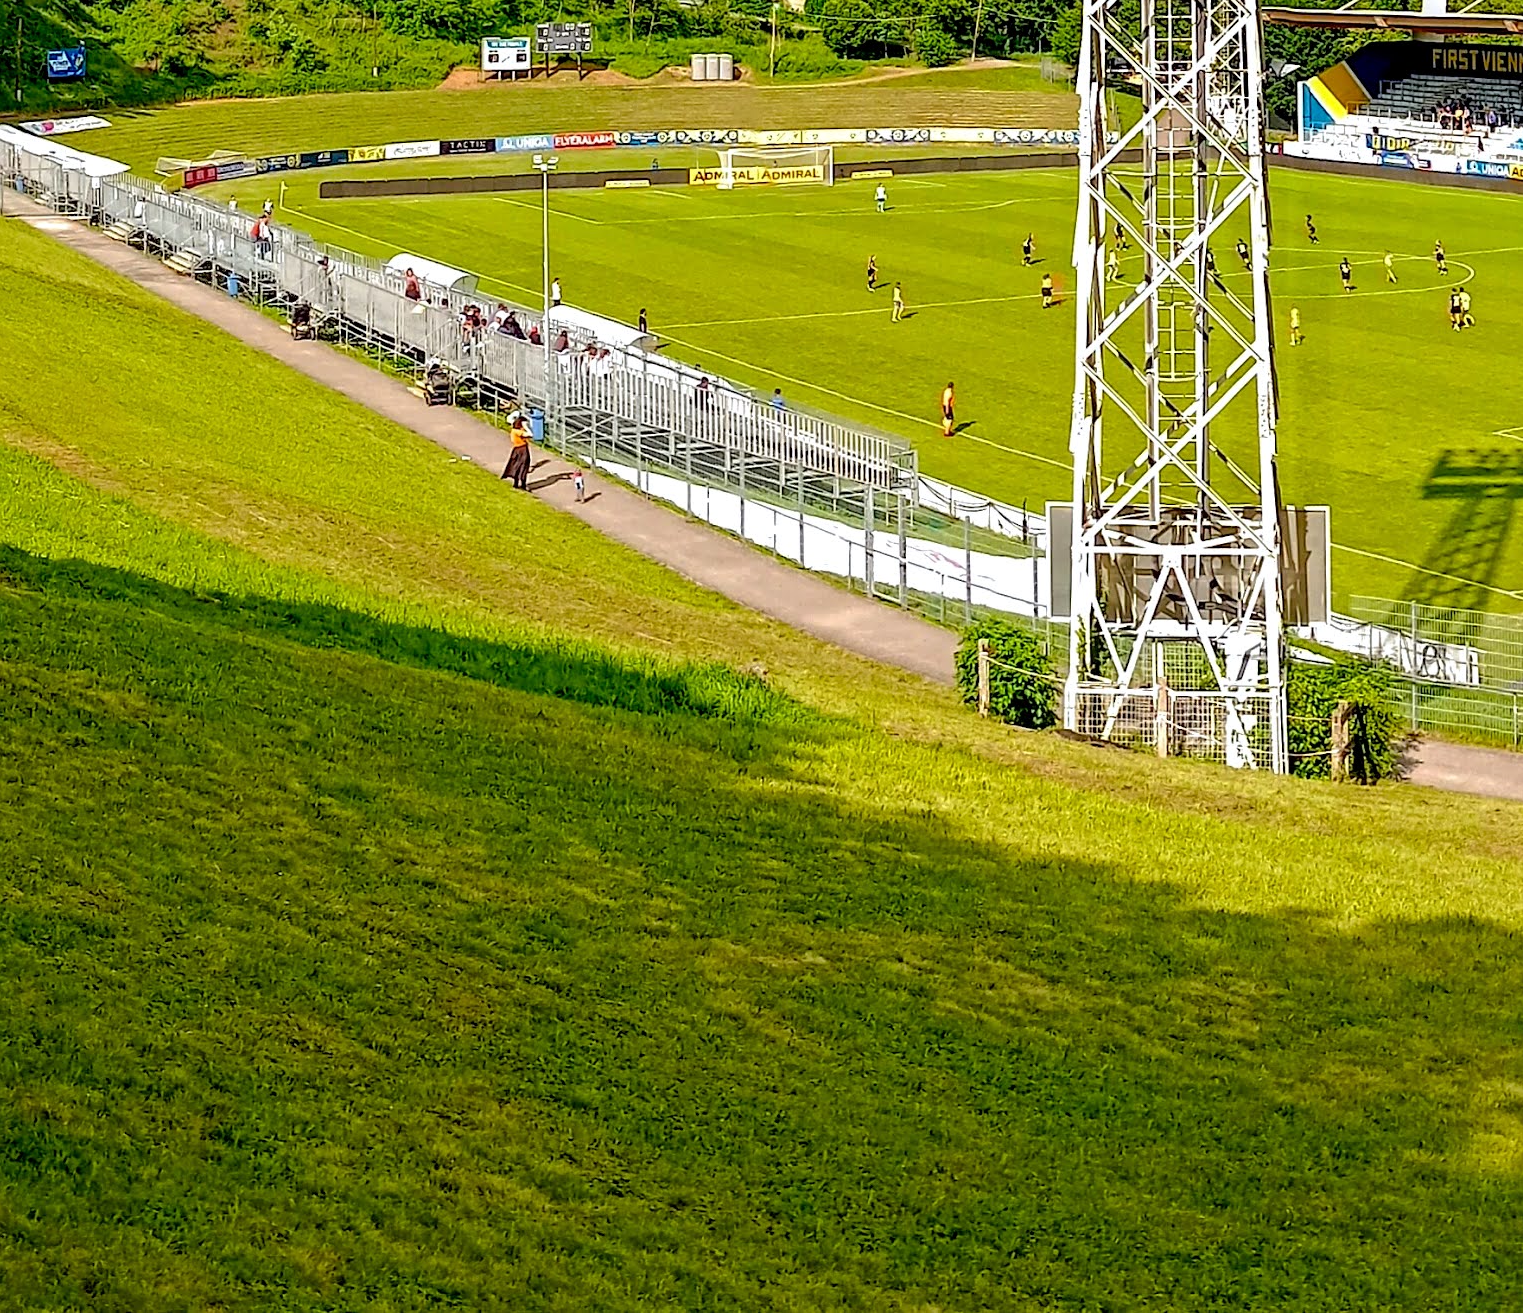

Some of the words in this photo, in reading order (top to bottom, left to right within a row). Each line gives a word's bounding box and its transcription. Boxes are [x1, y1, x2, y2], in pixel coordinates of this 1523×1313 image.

[1432, 48, 1477, 71] FIRST
[516, 136, 549, 149] UNIQA
[554, 133, 613, 148] FLYERALARM
[761, 167, 821, 181] ADMIRAL
[1482, 161, 1509, 177] UNIQA
